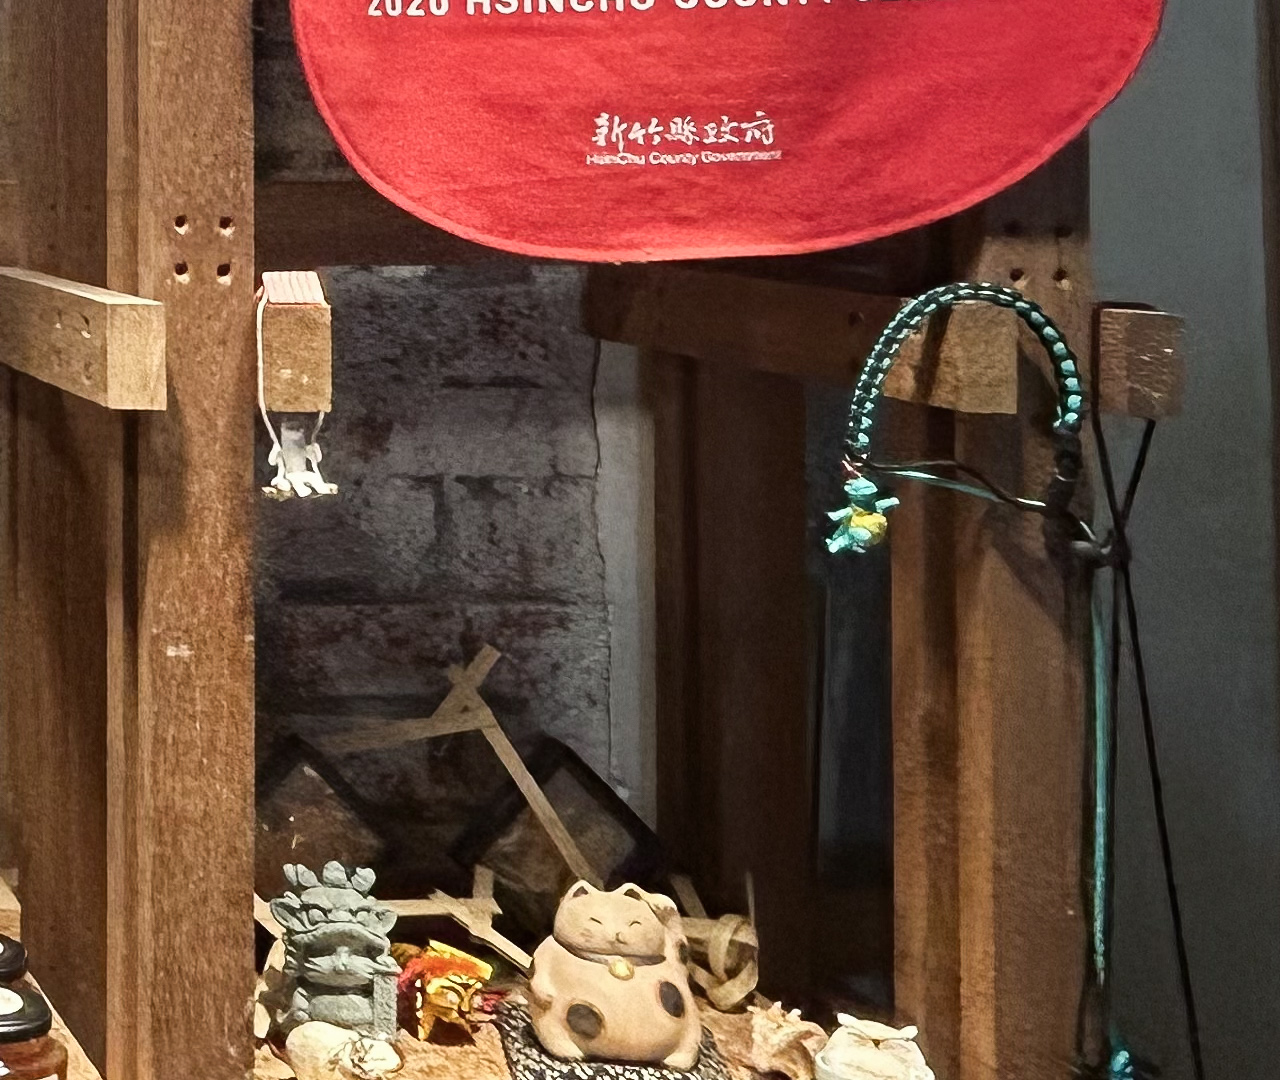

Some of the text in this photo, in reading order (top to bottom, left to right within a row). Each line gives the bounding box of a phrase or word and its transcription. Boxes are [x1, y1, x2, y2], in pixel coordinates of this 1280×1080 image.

[591, 111, 776, 155] 新竹縣政府
